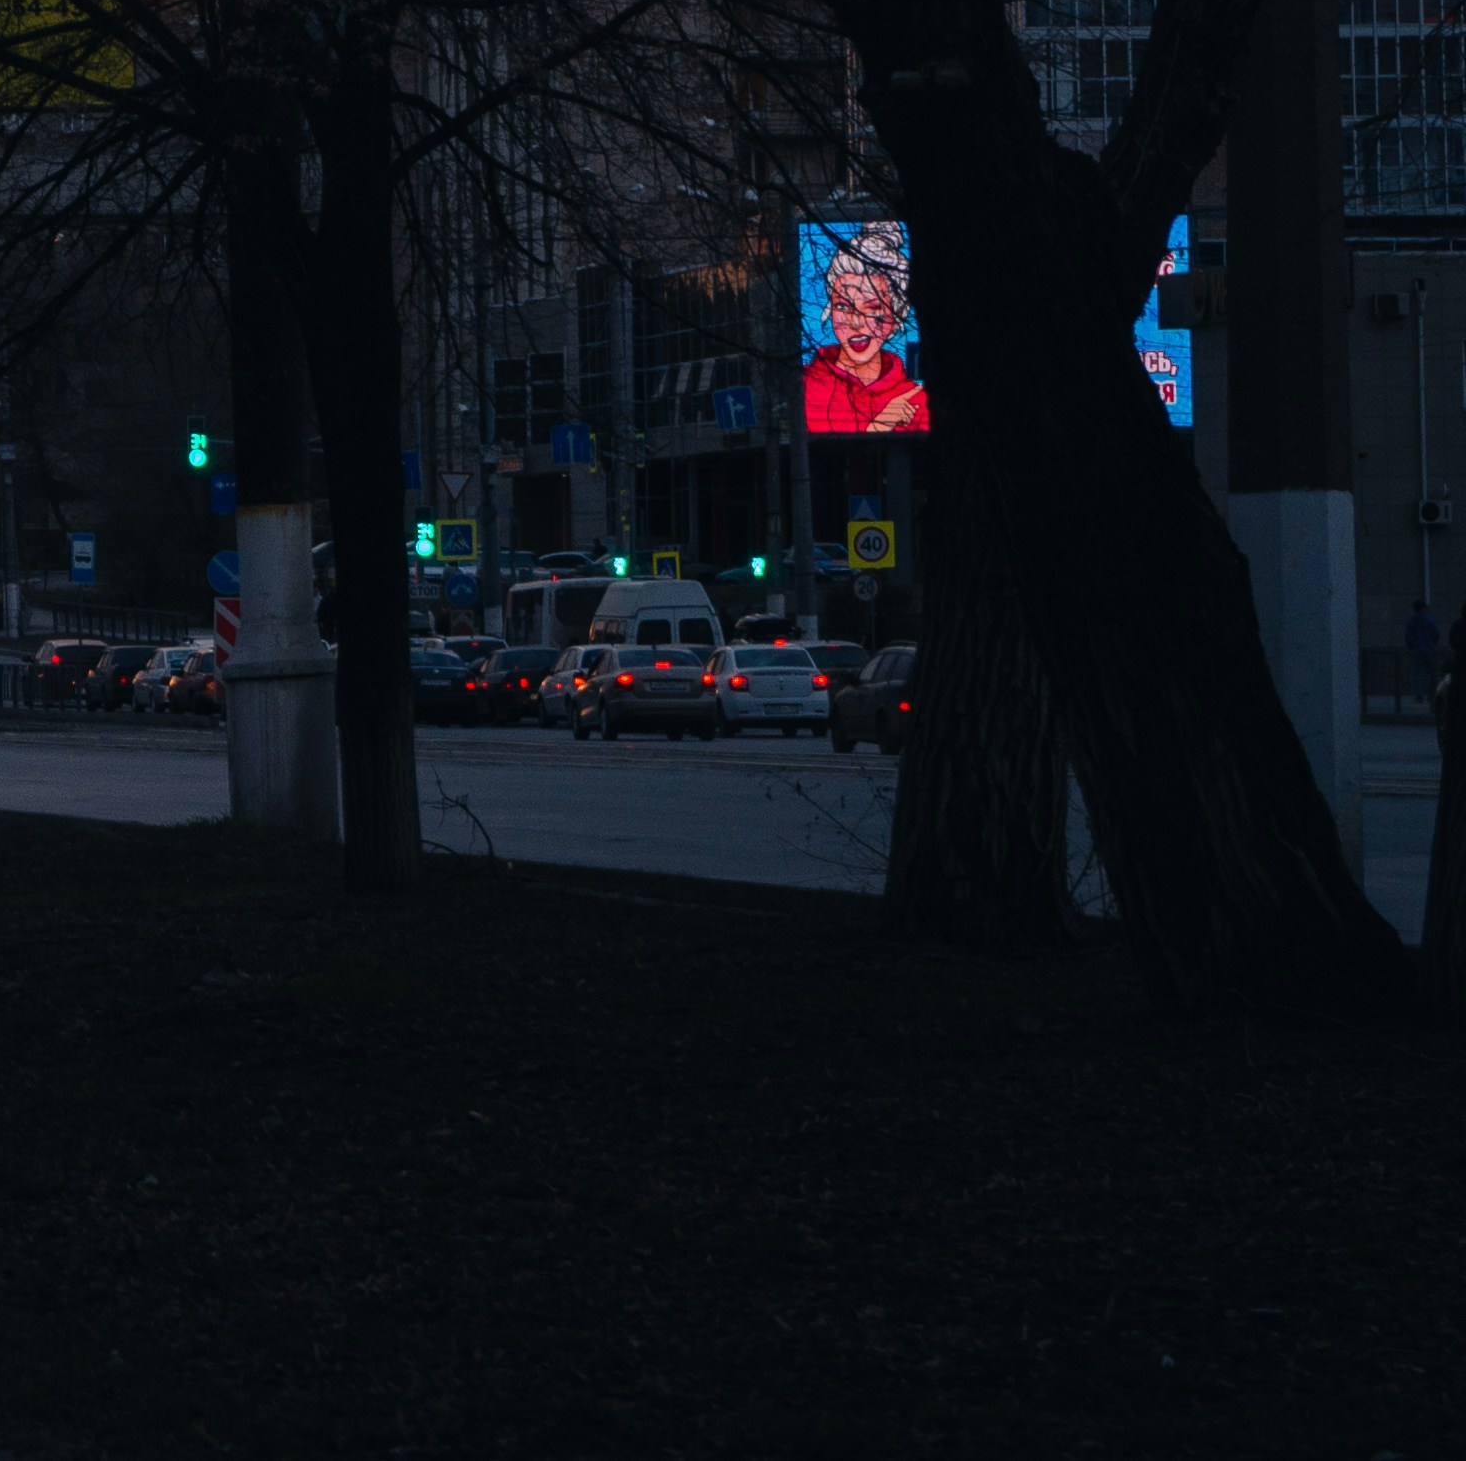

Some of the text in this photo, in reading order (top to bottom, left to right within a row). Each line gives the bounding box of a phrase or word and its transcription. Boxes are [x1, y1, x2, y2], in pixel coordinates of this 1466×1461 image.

[1140, 351, 1178, 377] СЬ,
[860, 536, 883, 552] 40
[409, 584, 438, 596] СТОП
